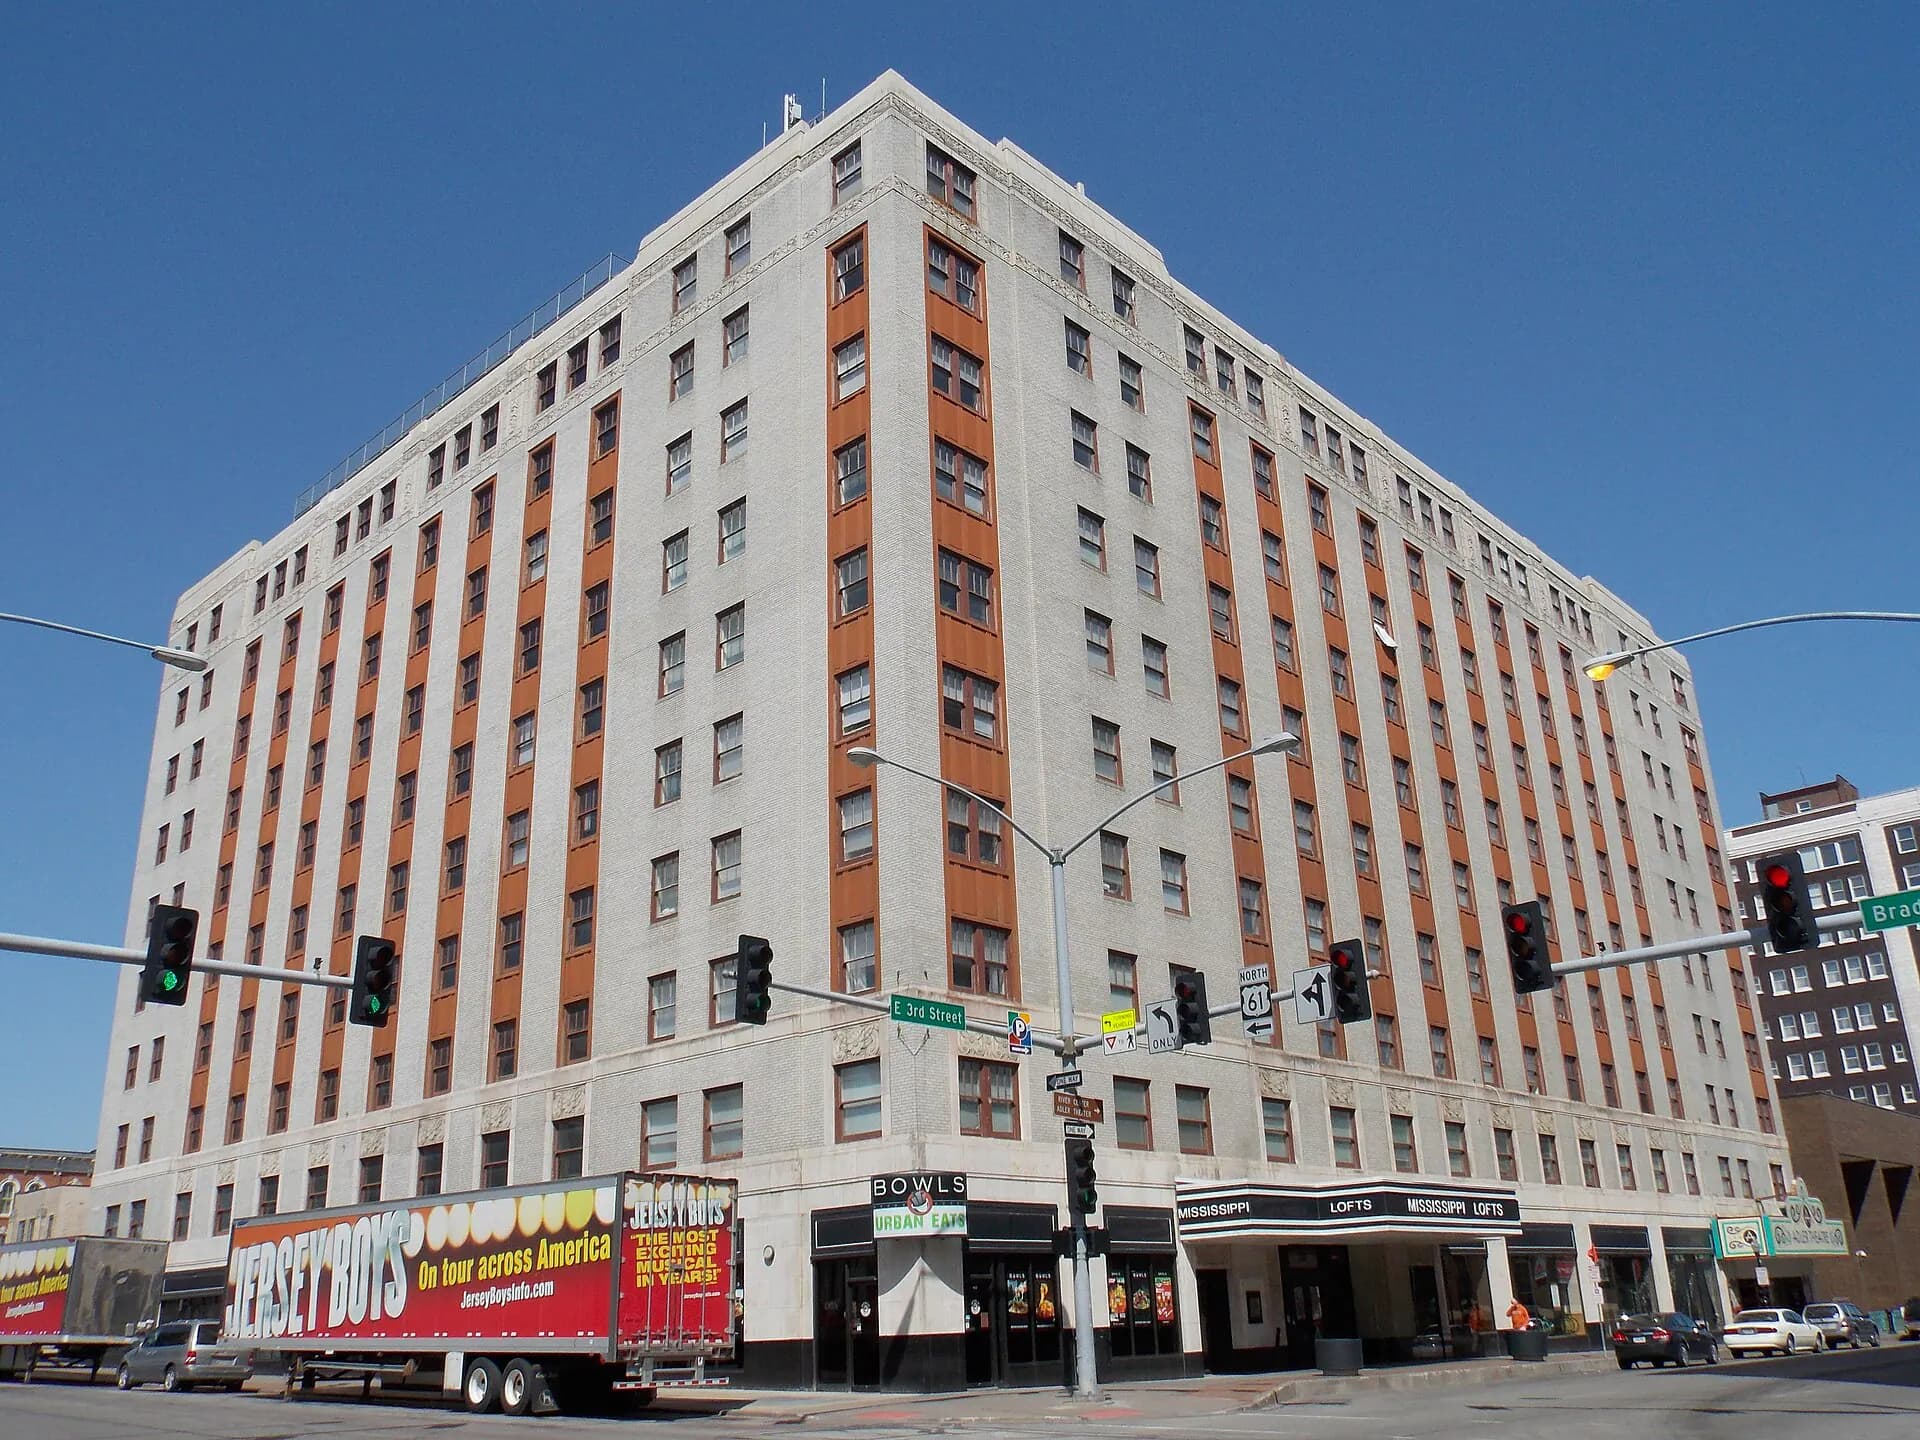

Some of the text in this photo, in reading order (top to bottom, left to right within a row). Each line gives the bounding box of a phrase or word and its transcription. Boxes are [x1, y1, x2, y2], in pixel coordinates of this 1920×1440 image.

[1239, 967, 1268, 983] NORTH
[1248, 991, 1264, 1012] 61
[894, 1001, 962, 1025] E 3rd Street
[1015, 1019, 1025, 1037] P
[1152, 1035, 1177, 1050] ONLY
[1068, 1075, 1078, 1083] WAY
[873, 1176, 965, 1197] BOWLS
[1178, 1201, 1249, 1219] MISSISSIPPI
[1330, 1199, 1372, 1213] LOFTS
[1407, 1198, 1504, 1217] MISSISSIPPI LOFTS
[875, 1212, 965, 1231] URBAN EATS
[418, 1230, 612, 1291] On tour across America
[636, 1242, 717, 1260] EXCITING
[223, 1208, 412, 1339] JERSEY BOYS
[636, 1274, 655, 1288] IN
[15, 1279, 39, 1300] across
[38, 1270, 69, 1295] America
[460, 1280, 554, 1310] JerseyBoysInfo.com
